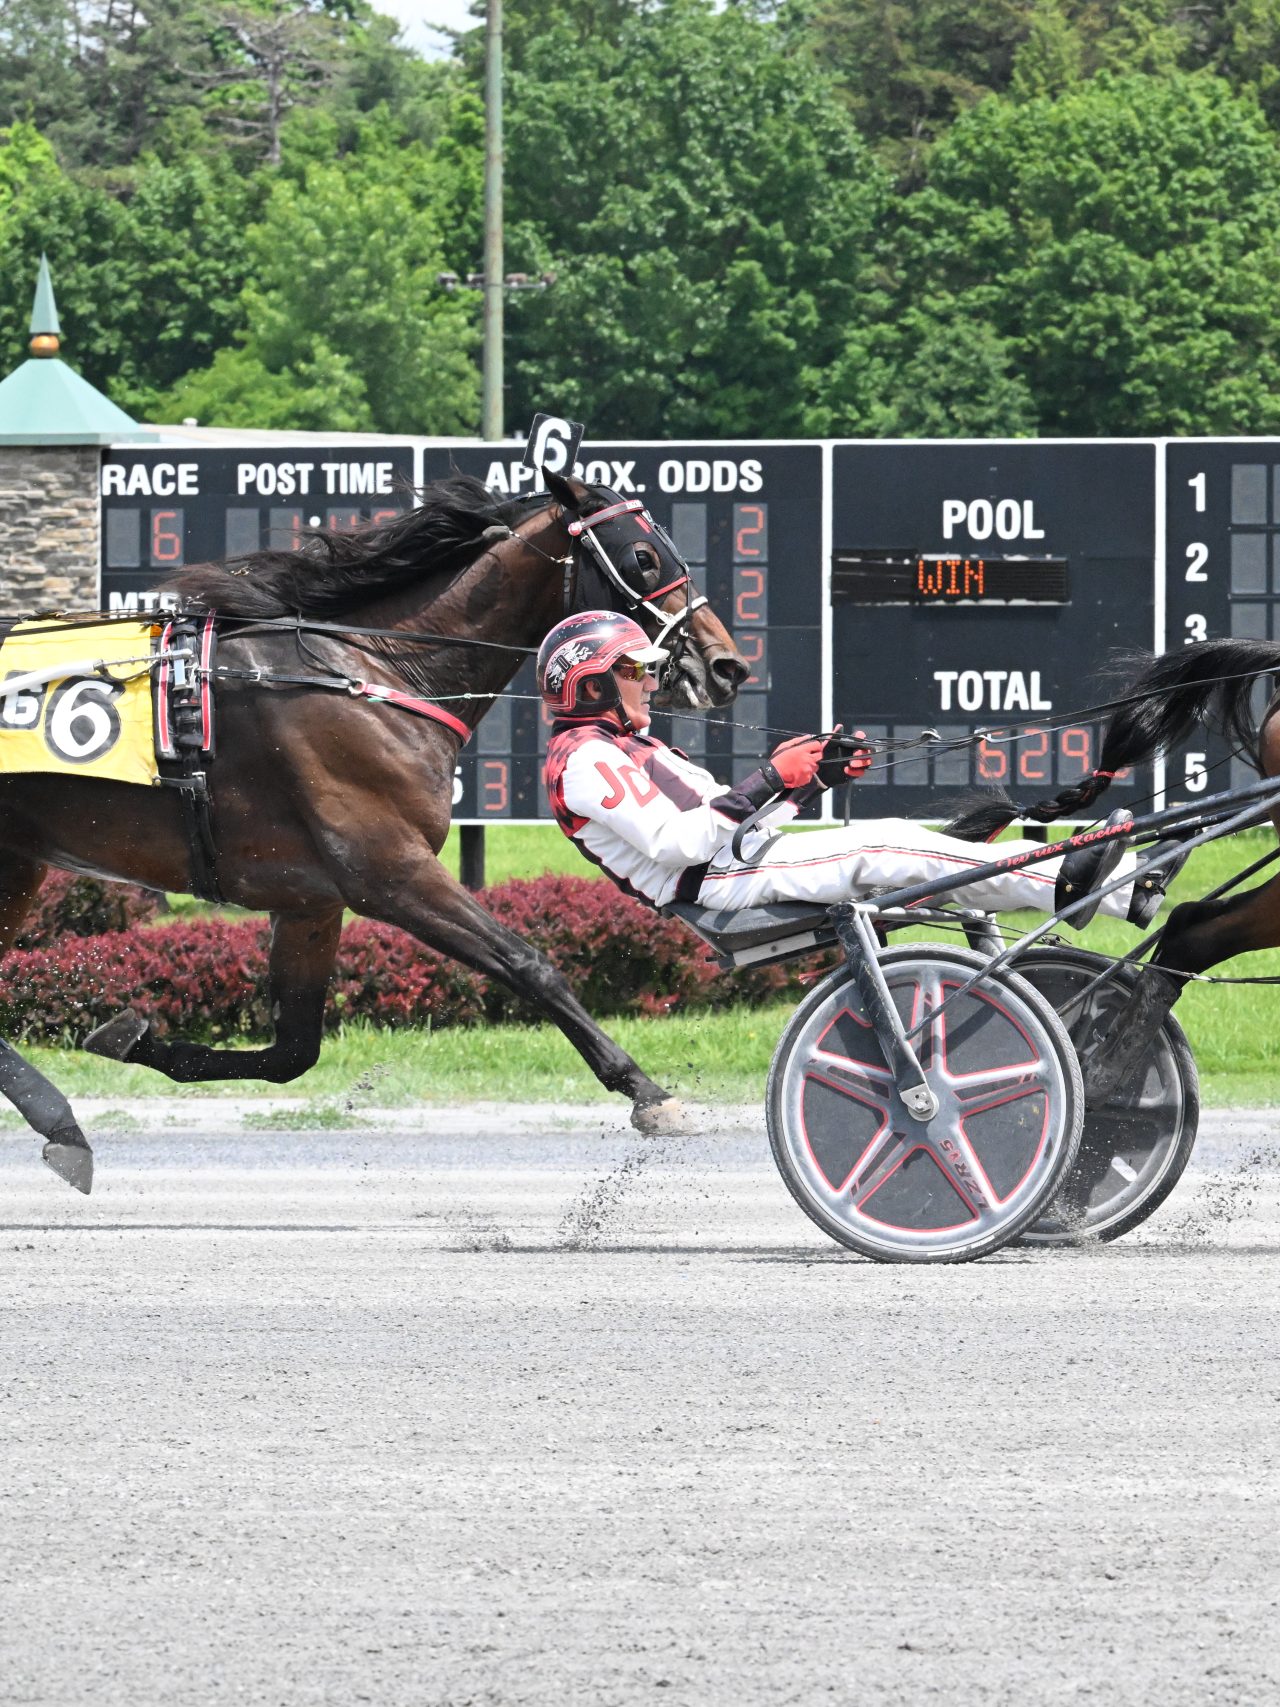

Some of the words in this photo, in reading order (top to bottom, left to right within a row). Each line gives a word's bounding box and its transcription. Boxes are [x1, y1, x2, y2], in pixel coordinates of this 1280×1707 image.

[533, 417, 572, 473] 6
[102, 462, 199, 496] RACE
[237, 462, 314, 495] POST
[325, 462, 393, 495] TIME
[658, 459, 763, 493] ODDS
[1187, 471, 1207, 513] 1
[152, 511, 181, 561] 6
[736, 506, 764, 556] 2
[942, 499, 1045, 540] POOL
[917, 559, 985, 595] WIN
[1184, 542, 1209, 583] 2
[736, 570, 764, 620] 2
[1184, 612, 1208, 645] 3
[933, 670, 1053, 711] TOTAL
[50, 679, 115, 758] 6
[483, 761, 508, 811] 3
[593, 760, 660, 809] JD
[1184, 751, 1209, 793] 5
[1070, 820, 1136, 848] Racing
